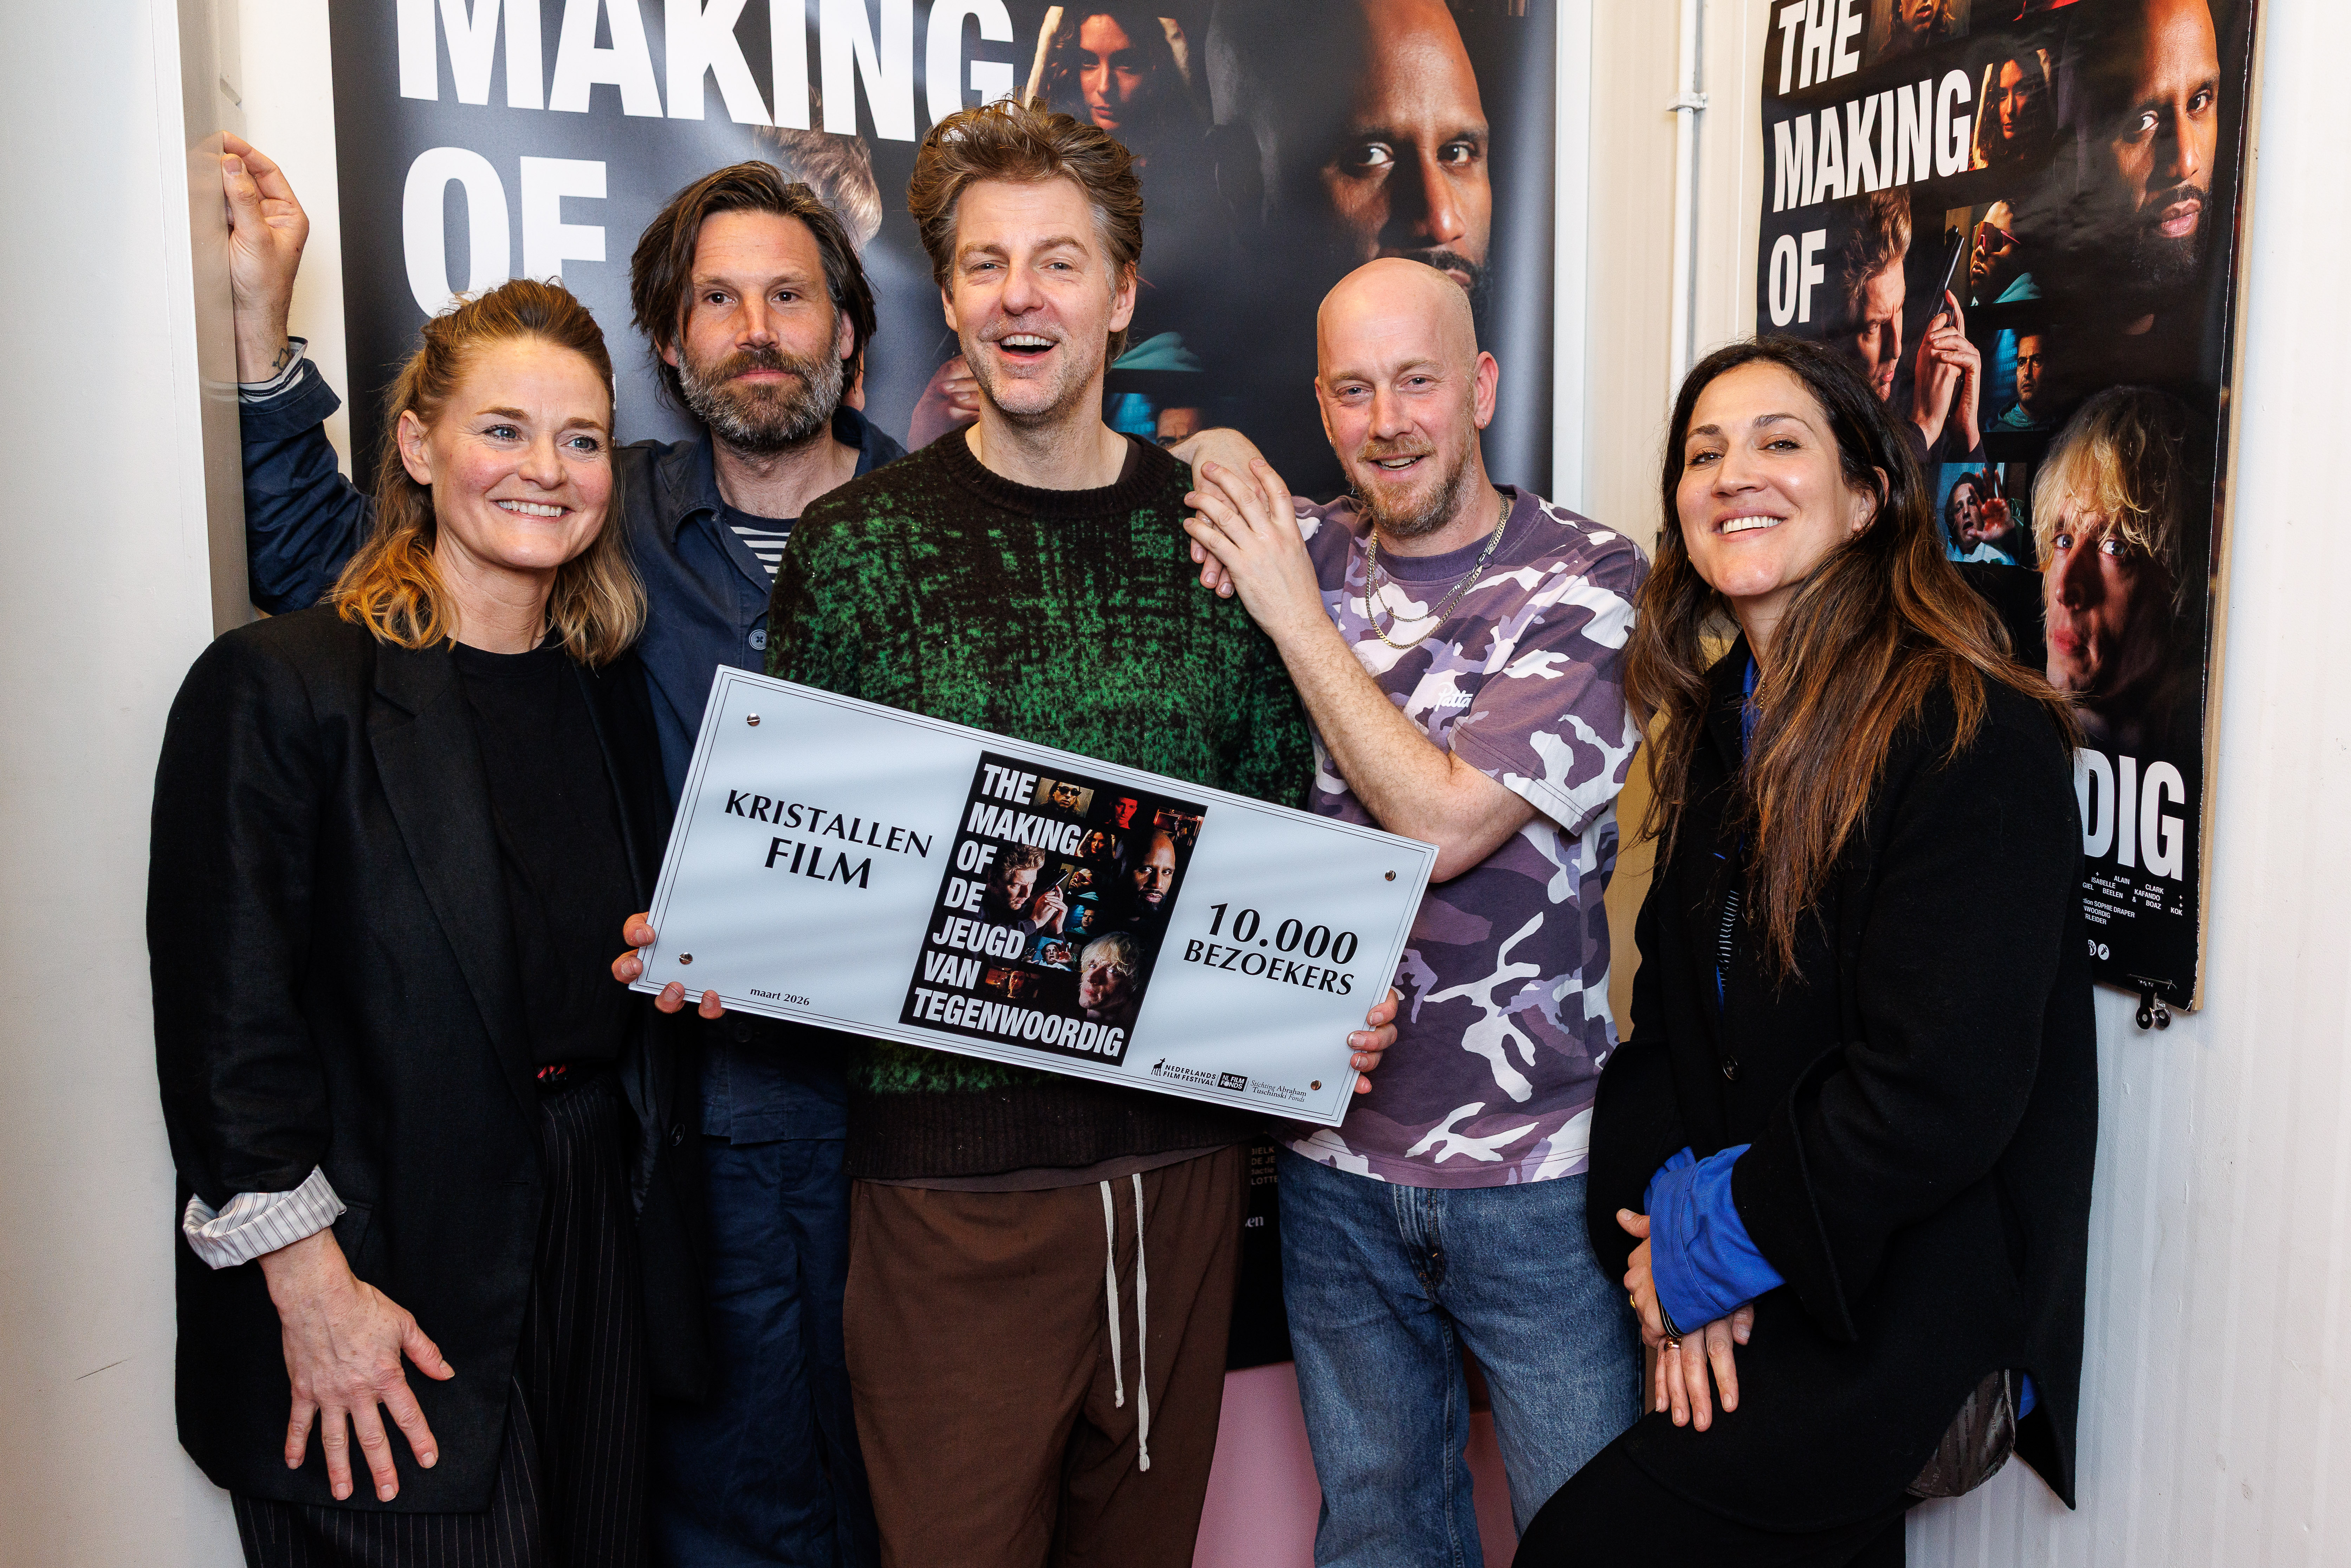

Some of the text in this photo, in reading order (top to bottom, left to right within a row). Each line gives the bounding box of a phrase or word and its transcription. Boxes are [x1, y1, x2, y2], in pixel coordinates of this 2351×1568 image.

[1778, 0, 1862, 95] THE
[395, 0, 1014, 142] MAKING
[1773, 69, 1972, 213] MAKING
[403, 147, 607, 317] OF
[1769, 228, 1824, 327] OF
[1435, 681, 1473, 712] Patta
[982, 763, 1037, 805] THE
[725, 789, 933, 858] KRISTALLEN
[967, 802, 1081, 856] MAKING
[764, 836, 872, 889] FILM
[957, 840, 998, 874] OF
[944, 877, 986, 913] DE
[2091, 877, 2116, 889] ISABELLE
[2134, 889, 2160, 901] KAFANDO
[2103, 888, 2123, 898] BEELEN
[2146, 900, 2161, 909] BOAZ
[2170, 907, 2182, 916] KOK
[2114, 876, 2130, 885] ALAIN
[2145, 884, 2164, 894] CLARK
[2094, 901, 2112, 911] SOPHIE
[2113, 907, 2135, 918] DRAPER
[932, 916, 1025, 960] JEUGD
[1209, 903, 1358, 964] 10.000
[924, 950, 982, 990] VAN
[1183, 939, 1354, 995] BEZOEKERS
[750, 989, 810, 1005] maart 2026
[913, 987, 1124, 1057] TEGENWOORDIG
[1162, 1071, 1214, 1086] FILM FESTIVAL
[1165, 1064, 1217, 1079] NEDERLANDS
[1220, 1080, 1242, 1089] FONDS
[1250, 1080, 1307, 1096] Stichting Abraham
[1252, 1087, 1305, 1102] Tuschinski Fonds
